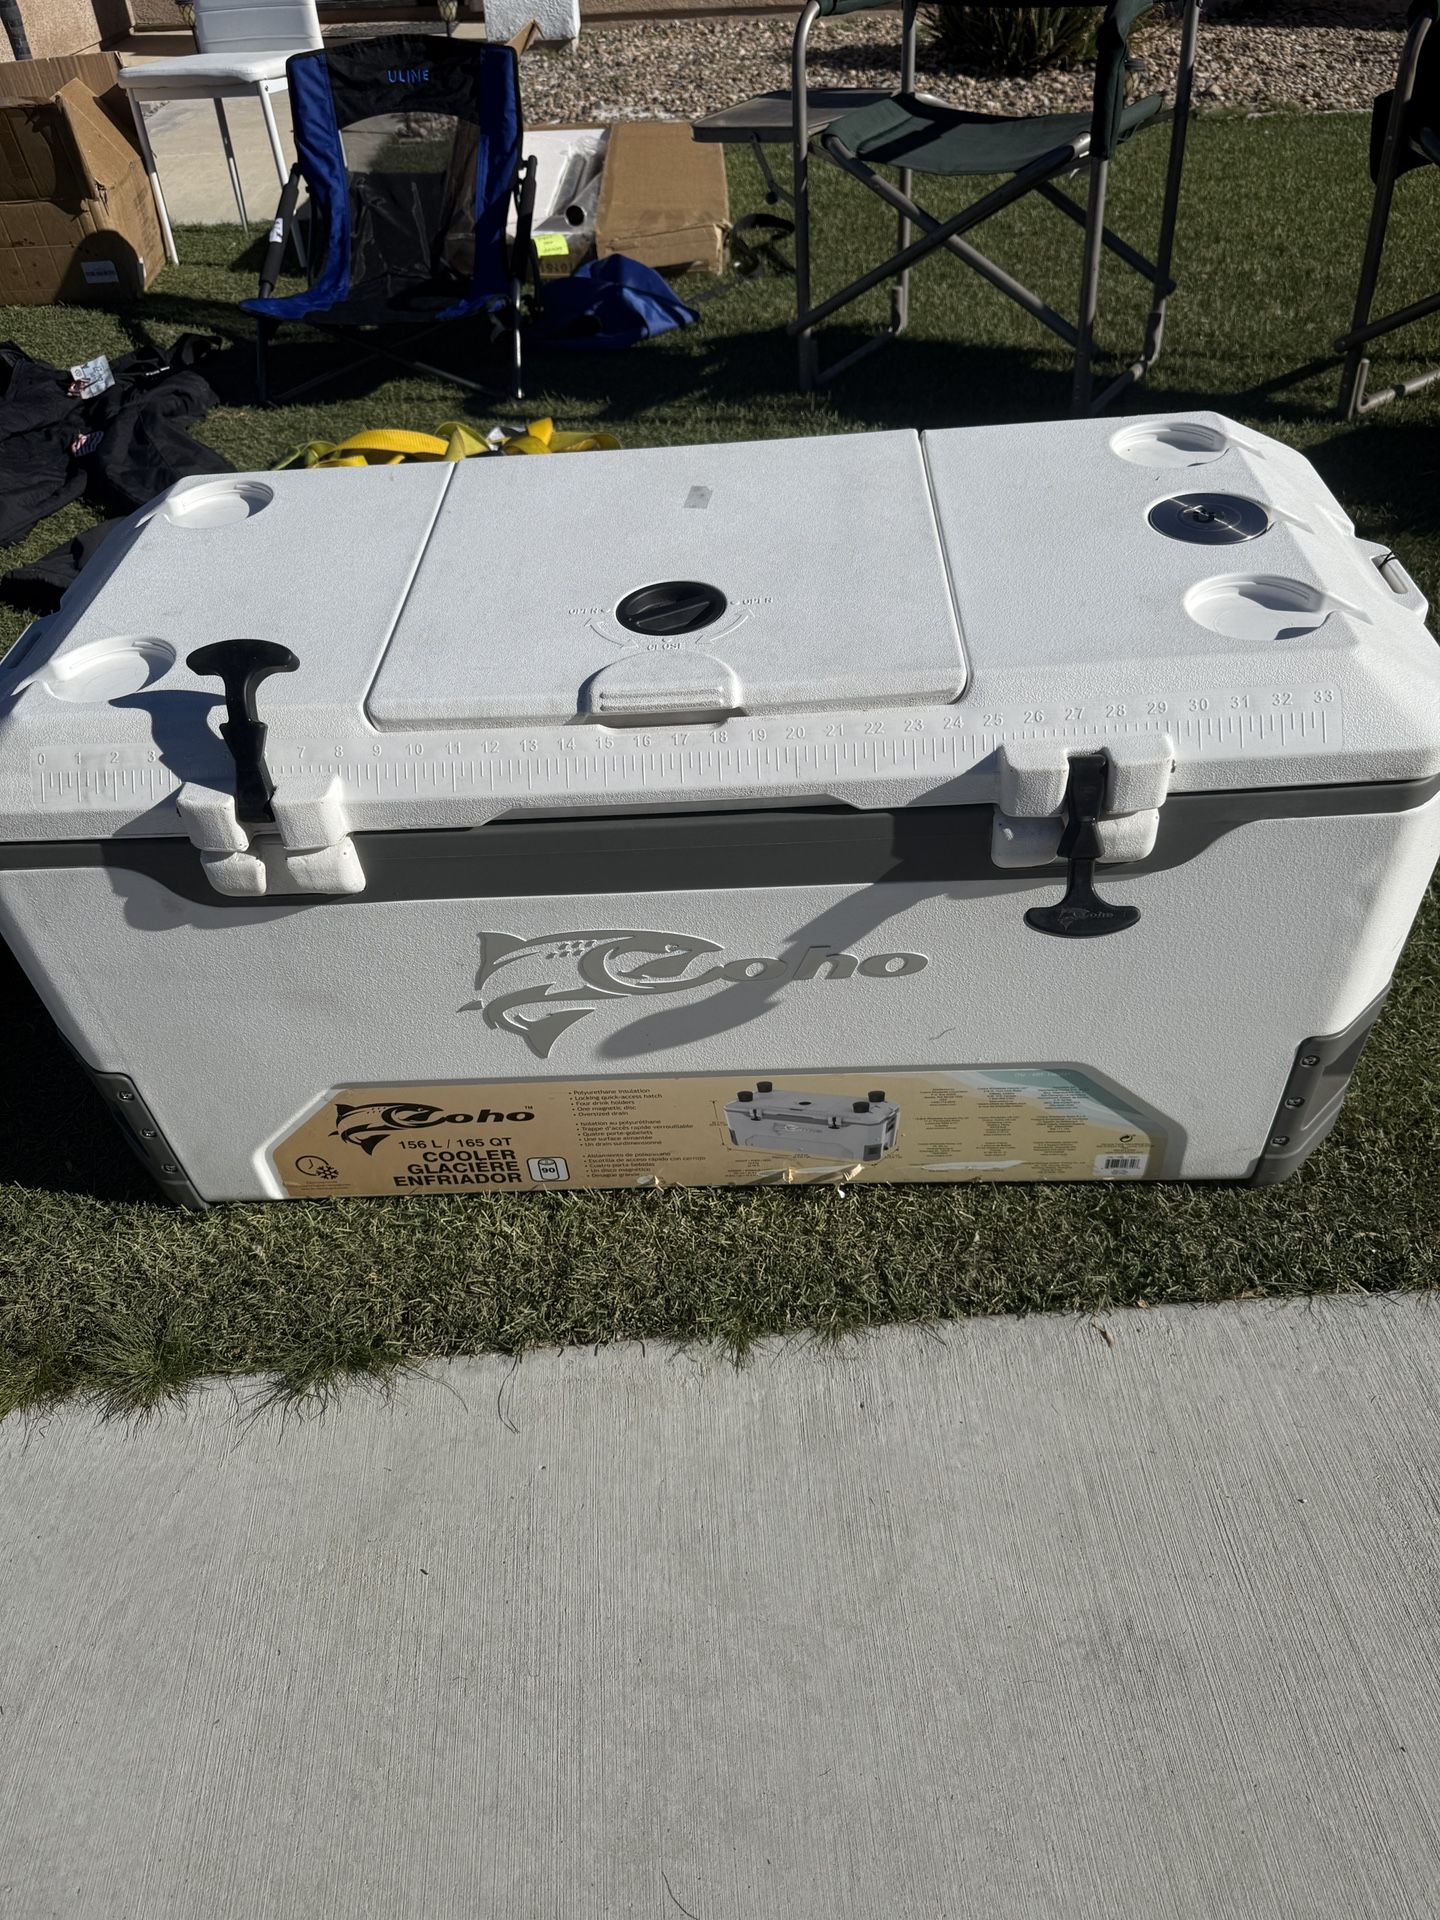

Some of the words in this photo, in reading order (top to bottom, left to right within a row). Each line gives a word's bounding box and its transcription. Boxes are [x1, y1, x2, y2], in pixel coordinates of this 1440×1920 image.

[387, 69, 429, 84] ULINE
[37, 753, 45, 765] 0
[75, 753, 81, 764] 1
[110, 752, 119, 764] 2
[147, 751, 155, 763] 3
[298, 746, 305, 758] 7
[335, 745, 344, 757] 8
[373, 744, 382, 757] 9
[406, 743, 423, 755] 10
[446, 742, 461, 754] 11
[481, 741, 499, 753] 12
[520, 739, 538, 752] 13
[558, 738, 576, 750] 14
[596, 736, 614, 749] 15
[634, 735, 651, 748] 16
[672, 733, 690, 746] 17
[710, 731, 728, 744] 18
[749, 729, 767, 742] 19
[786, 727, 805, 740] 20
[826, 724, 845, 737] 21
[864, 722, 885, 735] 22
[904, 719, 924, 732] 23
[943, 717, 964, 730] 24
[983, 714, 1003, 727] 25
[1024, 711, 1045, 724] 26
[1065, 708, 1085, 720] 27
[1106, 704, 1127, 718] 28
[1148, 701, 1168, 715] 29
[1189, 698, 1209, 712] 30
[1231, 696, 1249, 709] 31
[1272, 693, 1293, 706] 32
[1314, 690, 1335, 703] 33
[398, 1139, 427, 1150] 156
[431, 1139, 443, 1148] L
[456, 1138, 485, 1148] 165
[489, 1137, 512, 1147] QT
[422, 1149, 516, 1163] COOLER
[393, 1172, 523, 1187] ENFRIADOR
